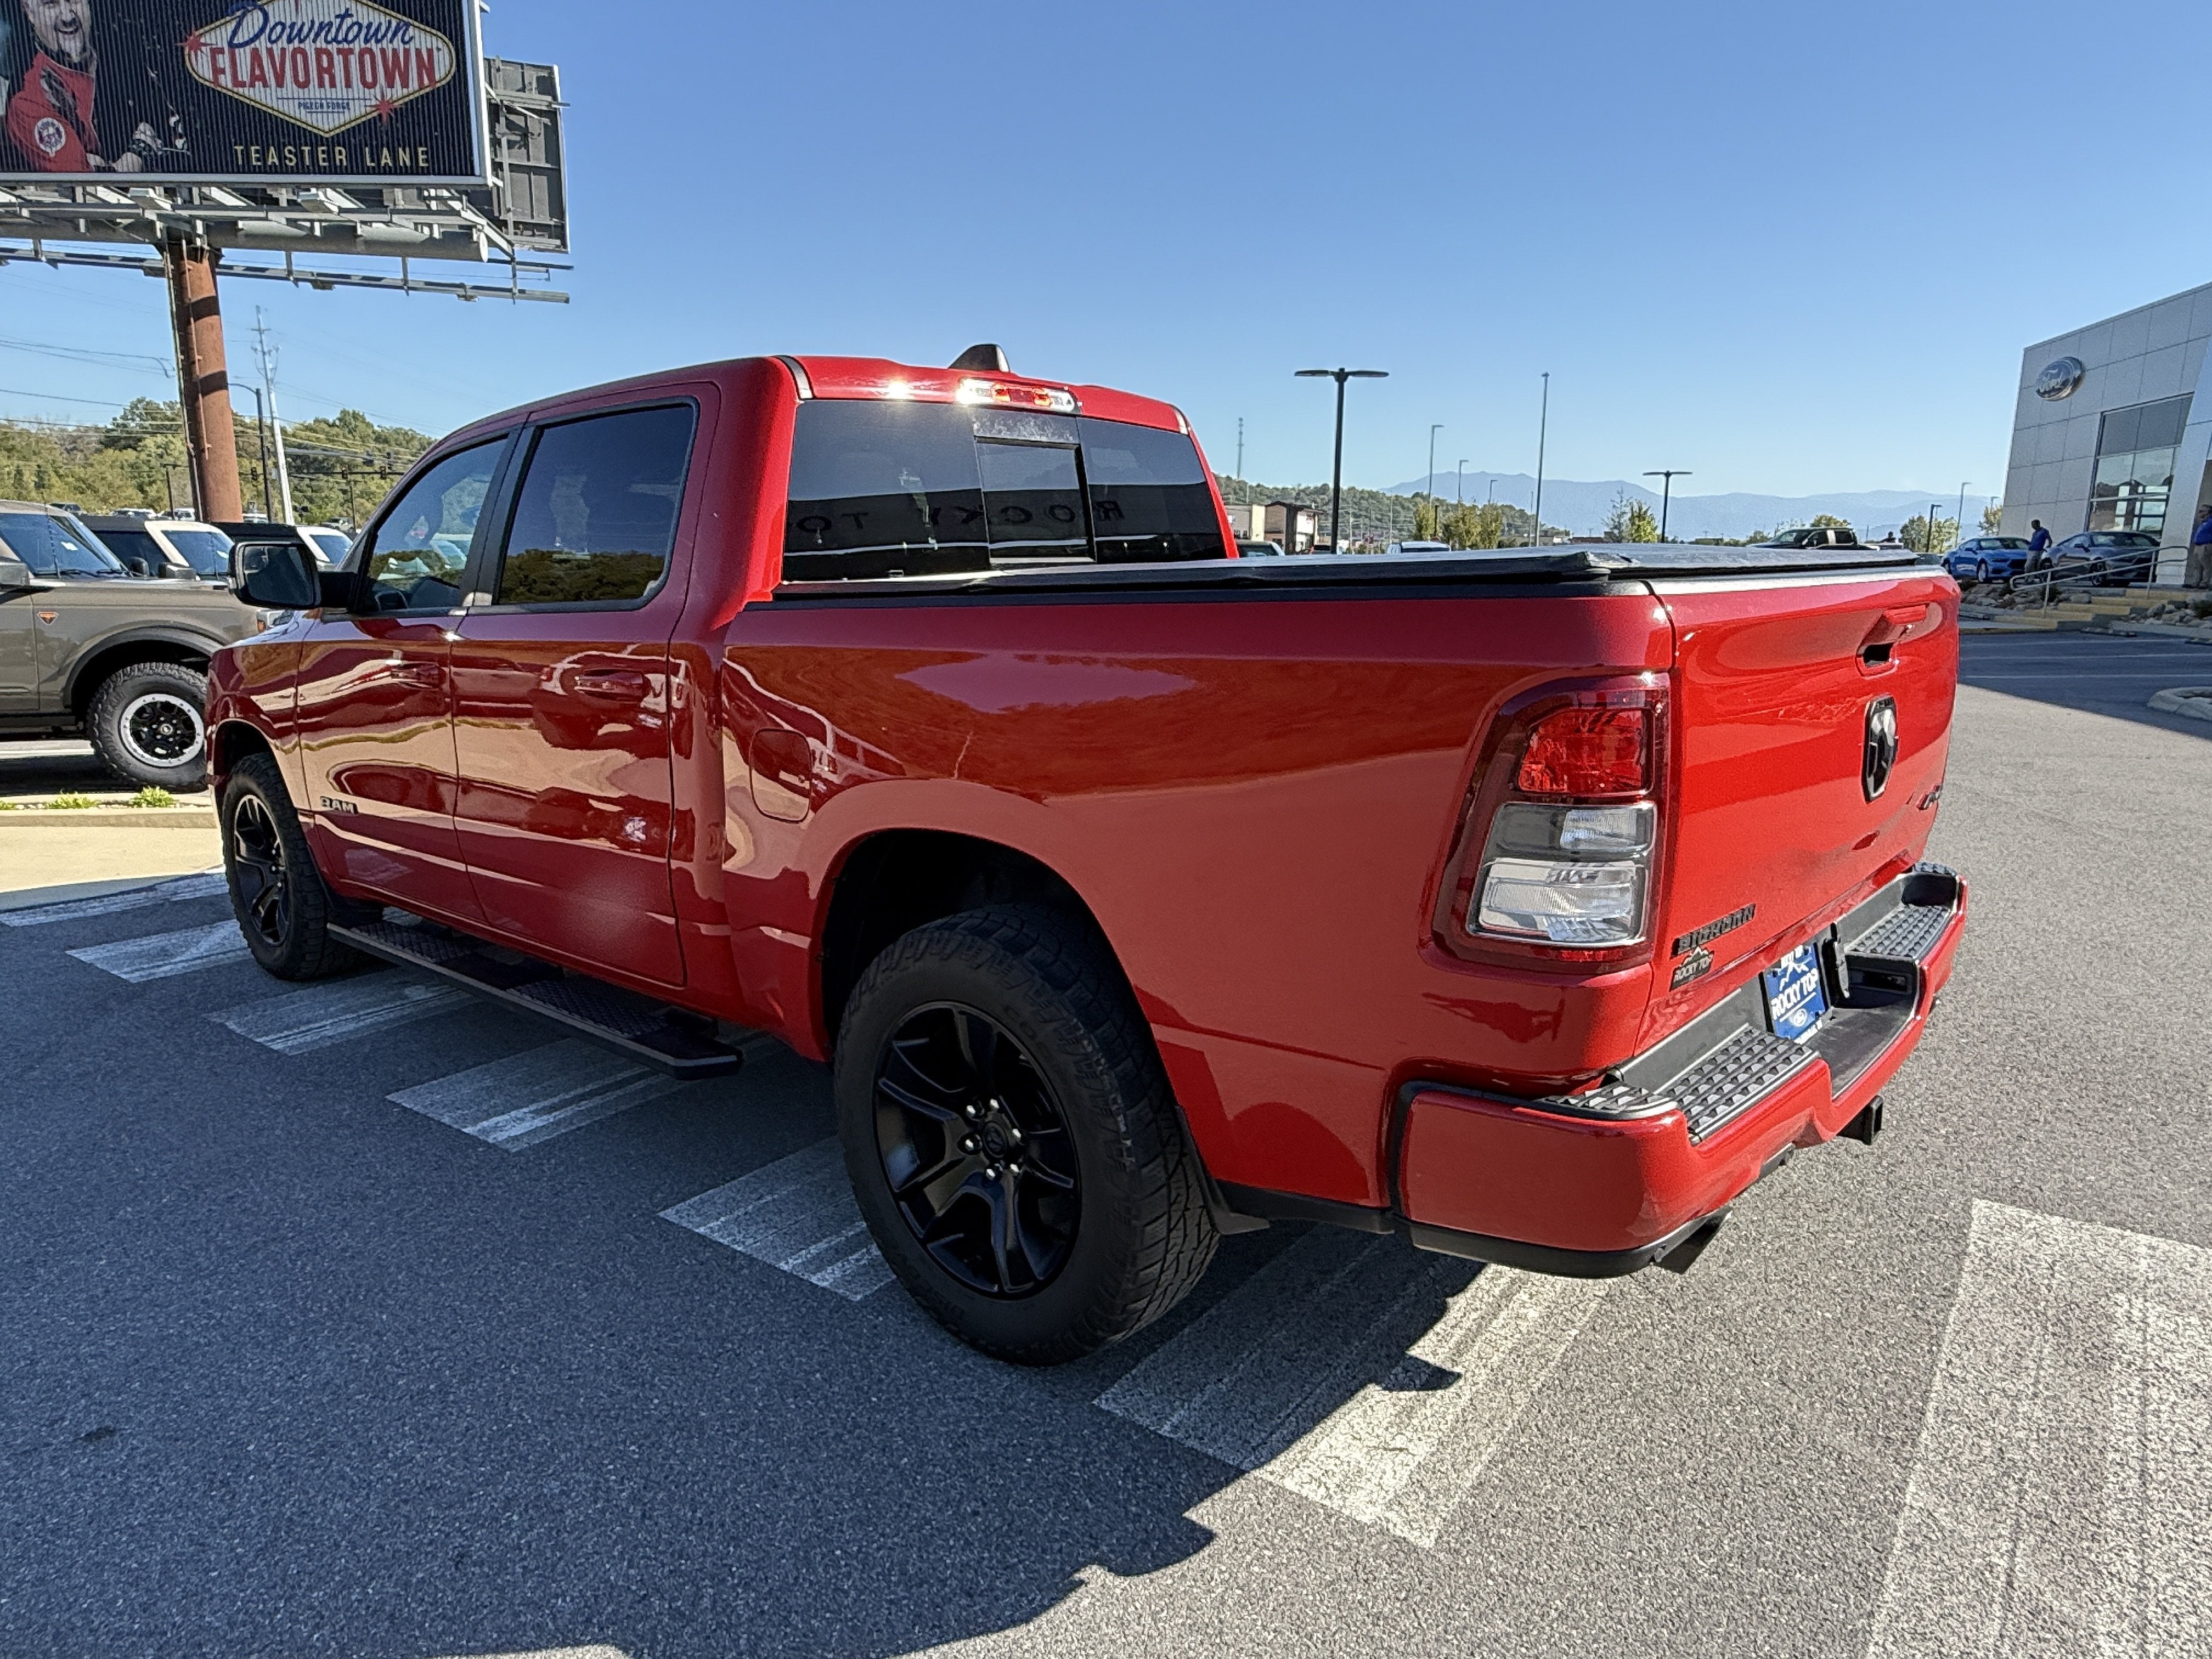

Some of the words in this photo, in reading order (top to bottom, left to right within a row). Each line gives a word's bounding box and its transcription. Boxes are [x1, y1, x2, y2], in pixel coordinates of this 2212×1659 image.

[227, 3, 414, 48] Downtown
[210, 47, 437, 89] FLAVORTOWN
[234, 145, 347, 167] TEASTER
[365, 147, 430, 167] LANE
[320, 795, 359, 815] RAM
[1771, 980, 1801, 1020] ROCKY
[1801, 968, 1818, 996] TOP
